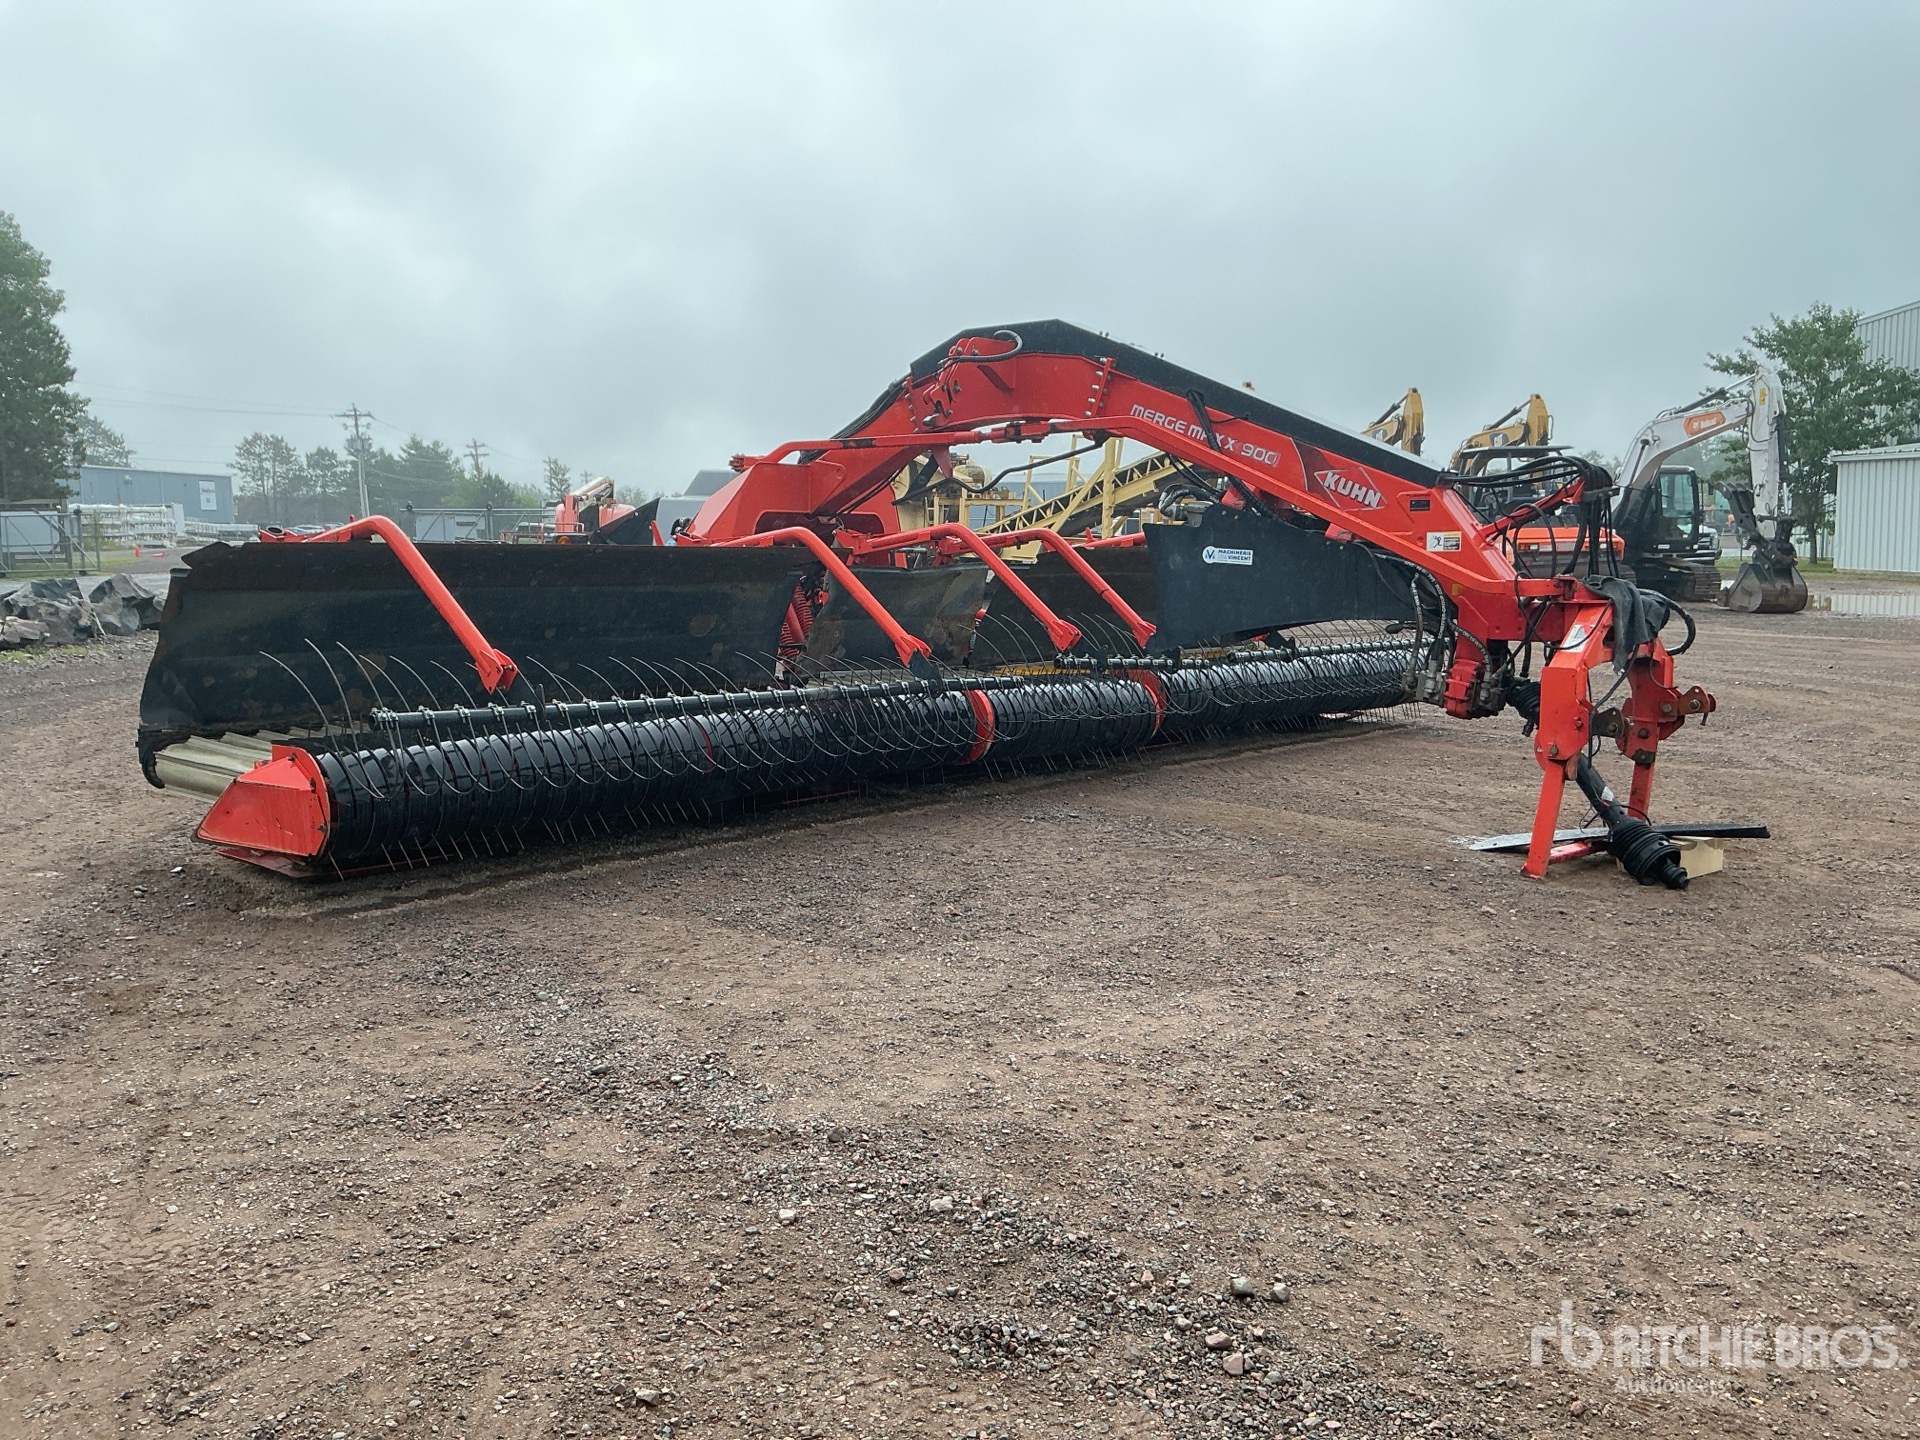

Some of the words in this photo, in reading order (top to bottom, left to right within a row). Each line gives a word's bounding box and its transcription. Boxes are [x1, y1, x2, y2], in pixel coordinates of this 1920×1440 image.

[1130, 404, 1187, 433] MERGE
[1241, 443, 1278, 466] 900
[1323, 471, 1381, 508] KUHN
